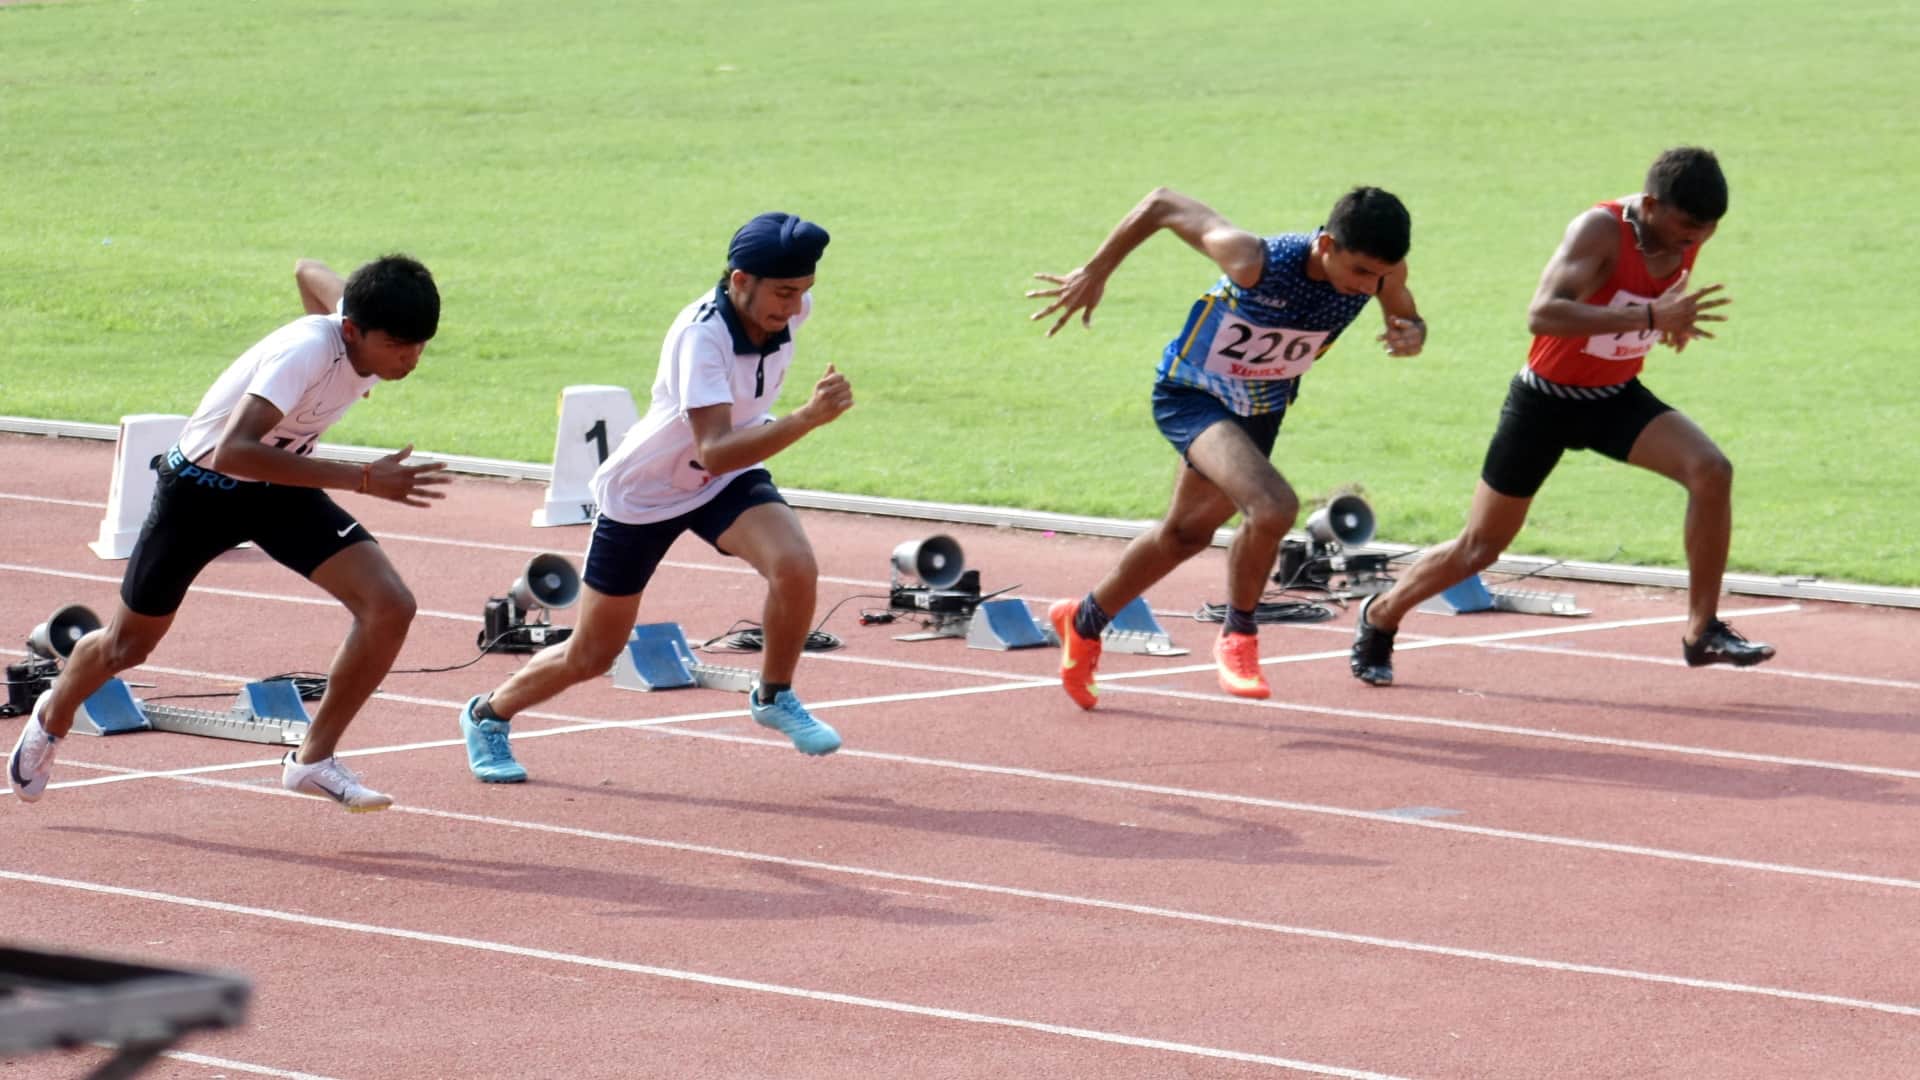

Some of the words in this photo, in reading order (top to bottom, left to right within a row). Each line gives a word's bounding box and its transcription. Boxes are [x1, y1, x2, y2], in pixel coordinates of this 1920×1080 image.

[1217, 323, 1315, 364] 226
[585, 420, 609, 466] 1
[179, 465, 239, 490] PRO
